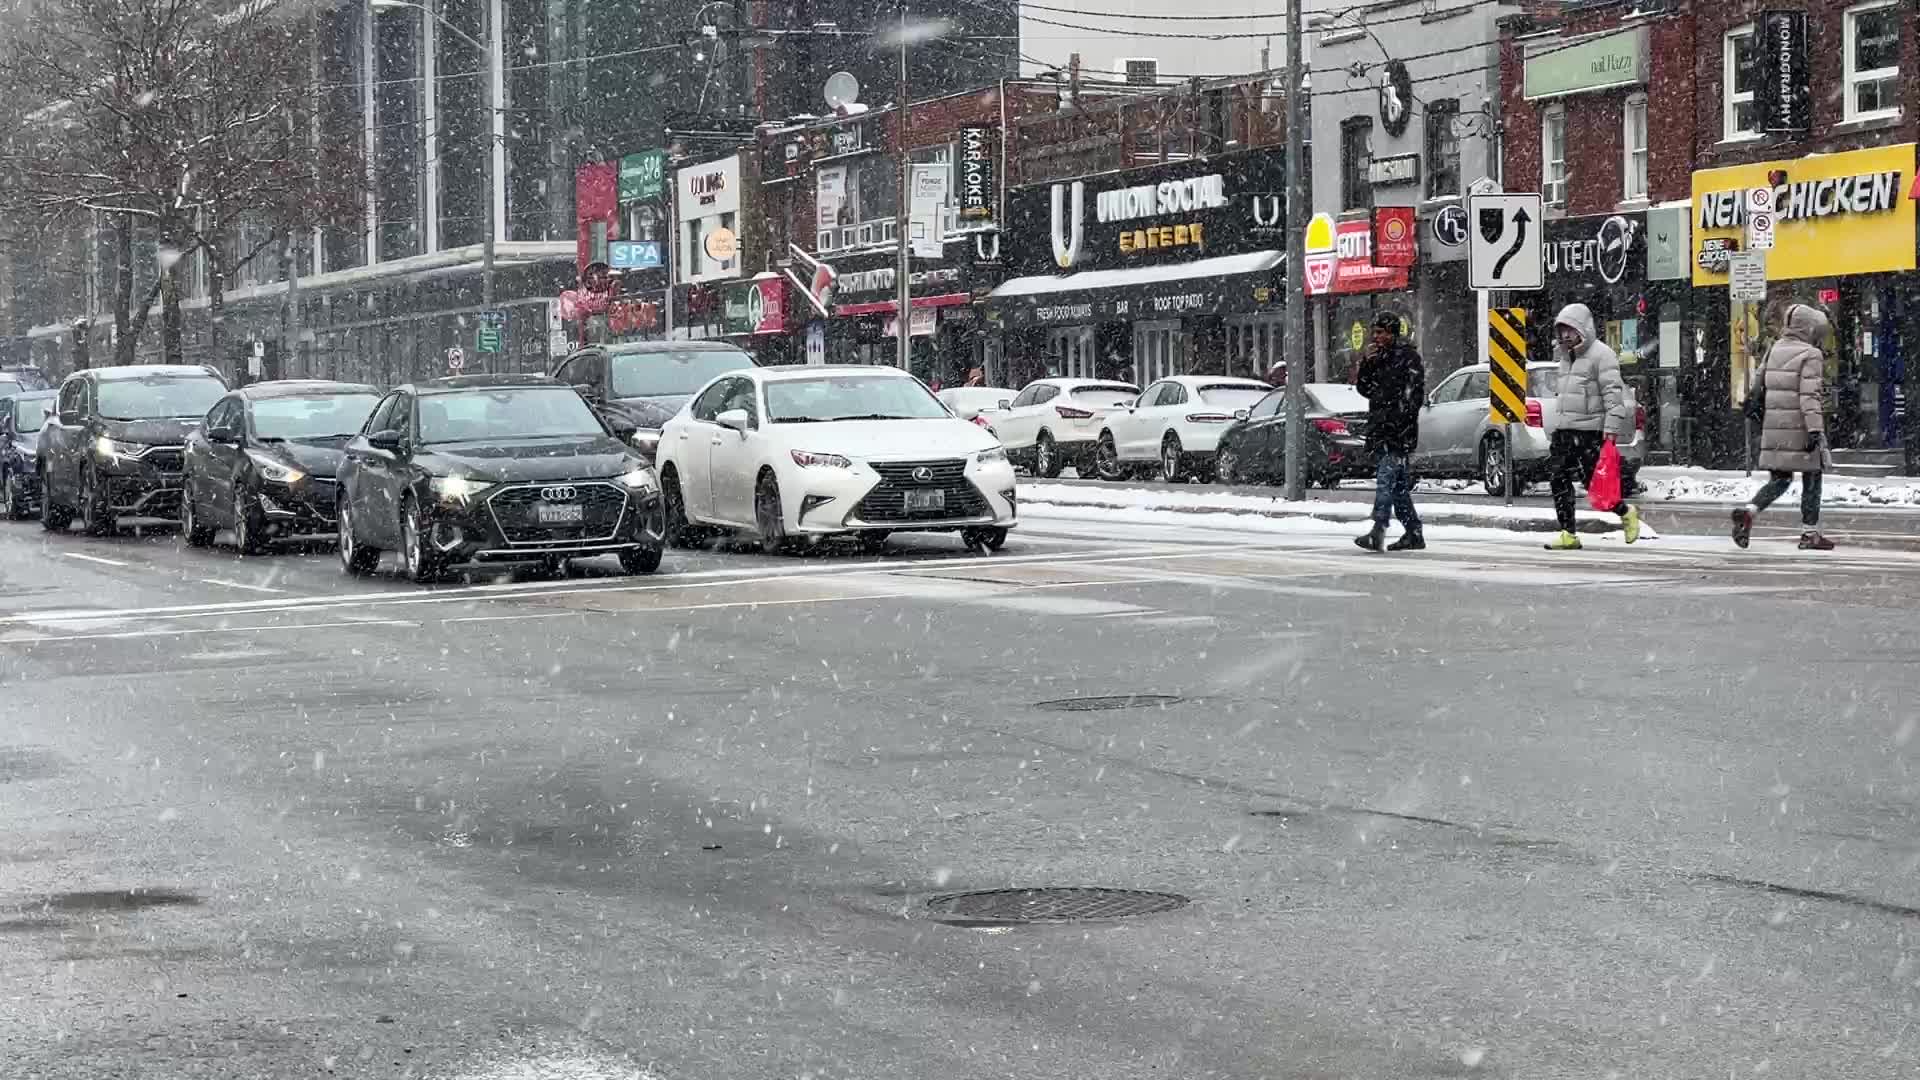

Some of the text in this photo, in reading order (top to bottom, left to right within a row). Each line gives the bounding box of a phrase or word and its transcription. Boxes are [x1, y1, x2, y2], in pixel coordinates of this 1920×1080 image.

[1780, 17, 1791, 124] MONOGRAPHY
[967, 128, 982, 205] KARAOKE
[1097, 174, 1226, 222] UNION SOCIAL
[1699, 172, 1897, 229] NEN CHICKEN
[615, 243, 658, 263] SPA
[1560, 240, 1596, 272] TEA
[1036, 306, 1053, 320] FRESH
[1116, 300, 1129, 314] BAR
[1154, 295, 1171, 312] ROOF
